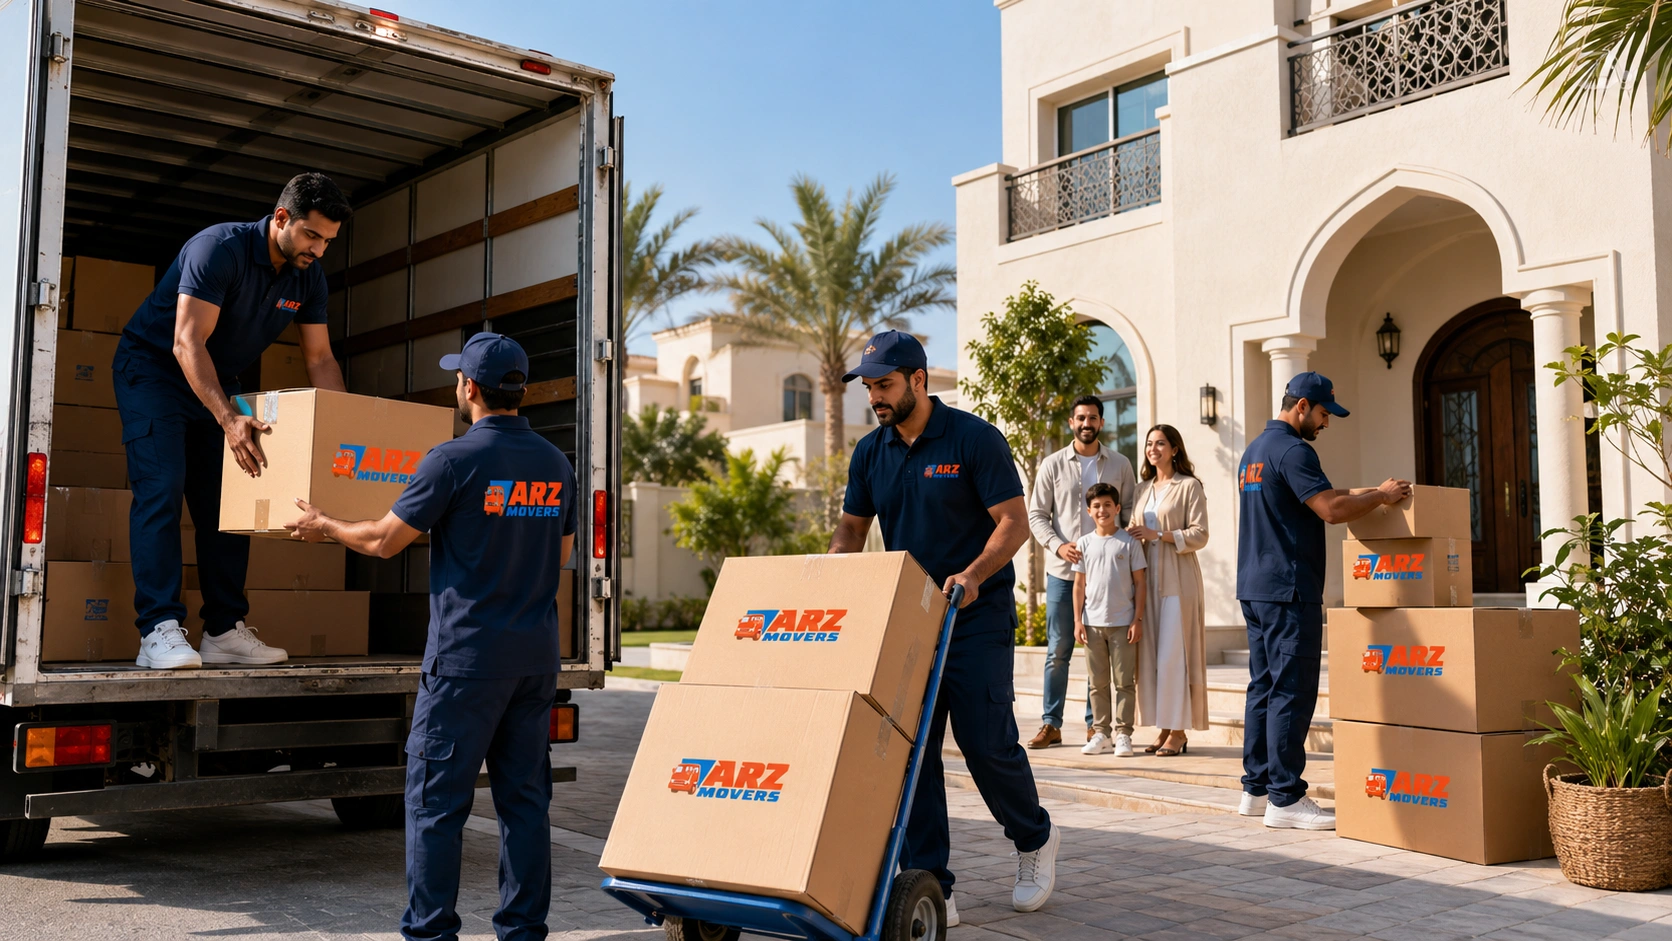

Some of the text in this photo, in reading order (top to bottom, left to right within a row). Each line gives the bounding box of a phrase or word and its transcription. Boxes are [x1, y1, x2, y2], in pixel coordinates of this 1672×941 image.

[359, 447, 421, 475] ARZ
[935, 464, 960, 474] ARZ
[507, 481, 563, 506] ARZ
[505, 506, 560, 517] MOVERS
[1375, 553, 1425, 572] ARZ
[1373, 571, 1423, 580] MOVERS
[766, 609, 848, 632] ARZ
[761, 632, 840, 642] MOVERS
[1386, 645, 1446, 667] ARZ
[1385, 665, 1444, 676] MOVERS
[701, 760, 790, 790] ARZ
[1390, 771, 1451, 799] ARZ
[696, 786, 781, 802] MOVERS
[1388, 792, 1448, 808] MOVERS
